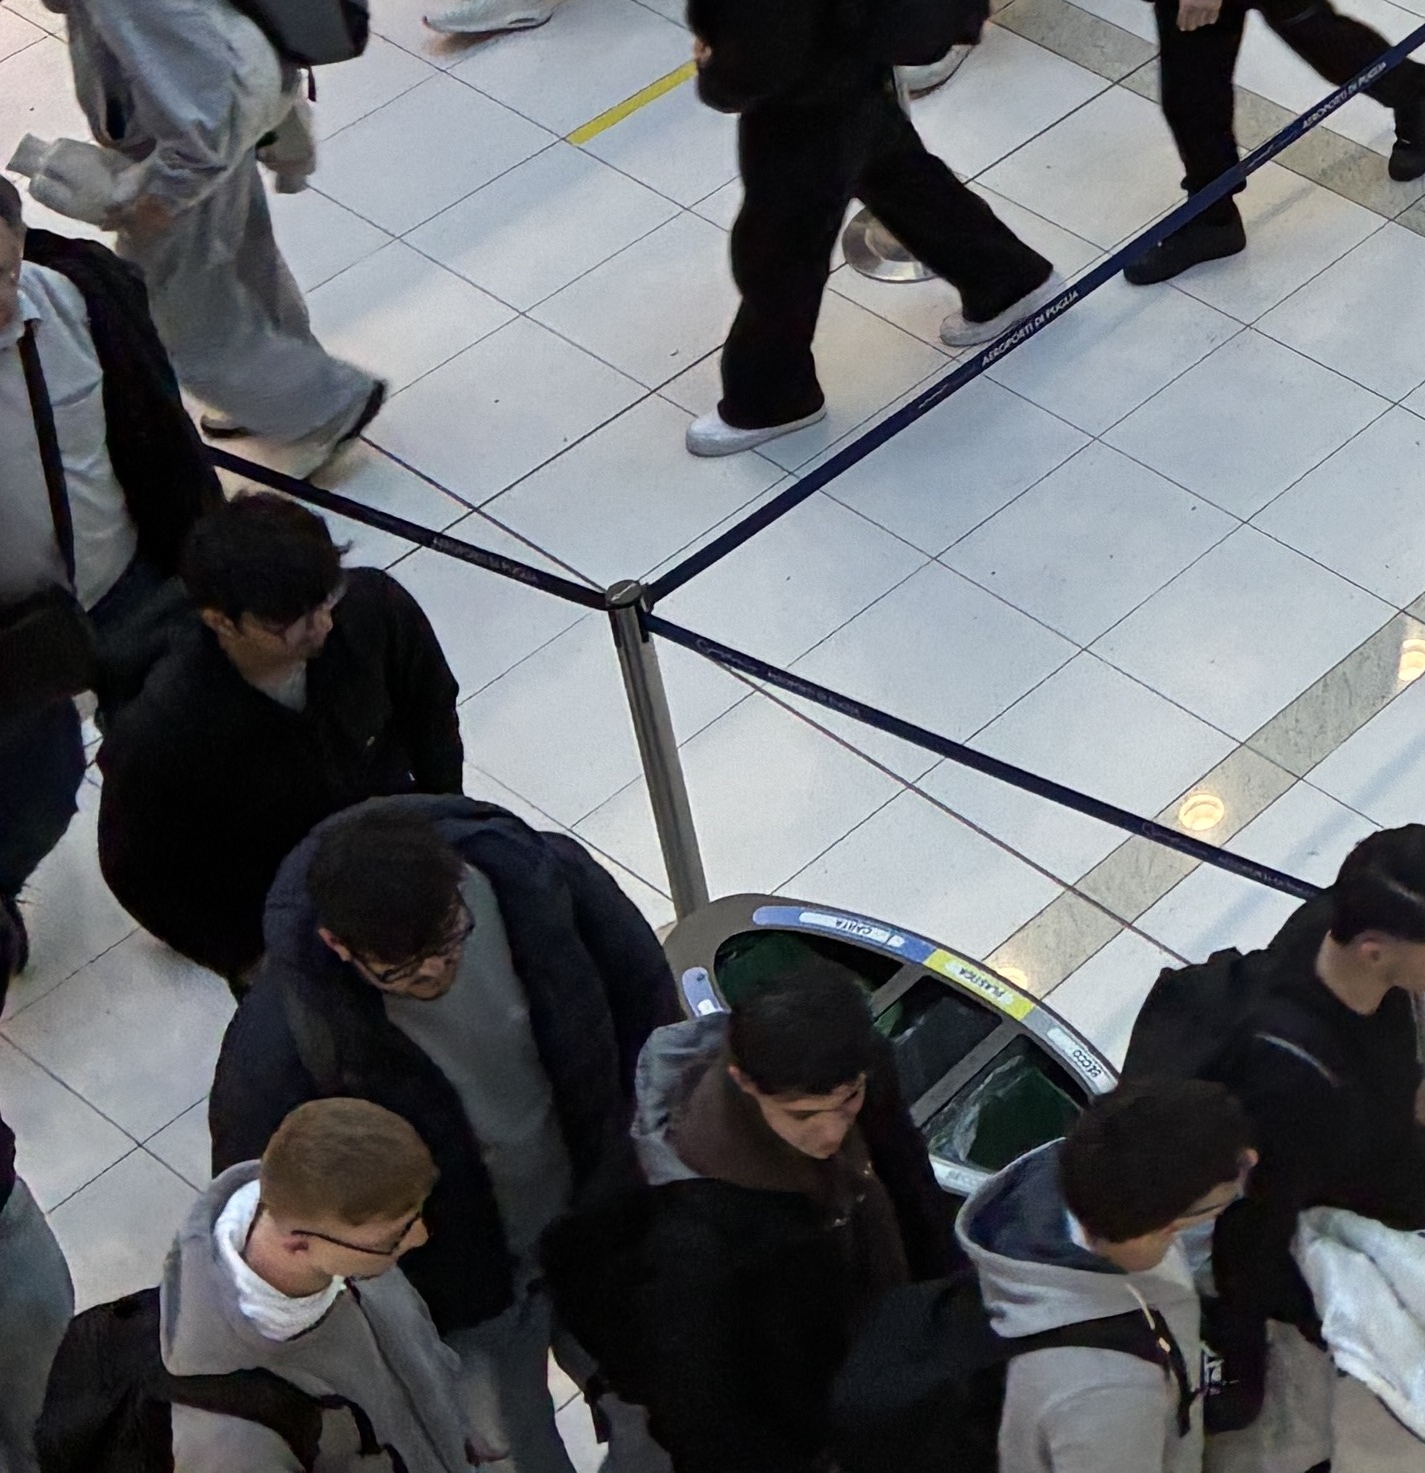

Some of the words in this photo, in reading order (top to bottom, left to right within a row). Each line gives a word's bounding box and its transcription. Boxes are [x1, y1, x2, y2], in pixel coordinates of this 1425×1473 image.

[981, 319, 1035, 367] AEROPORTI
[1034, 314, 1045, 327] DI
[1046, 290, 1079, 321] PUGLIA
[959, 967, 1006, 998] PLASTICA
